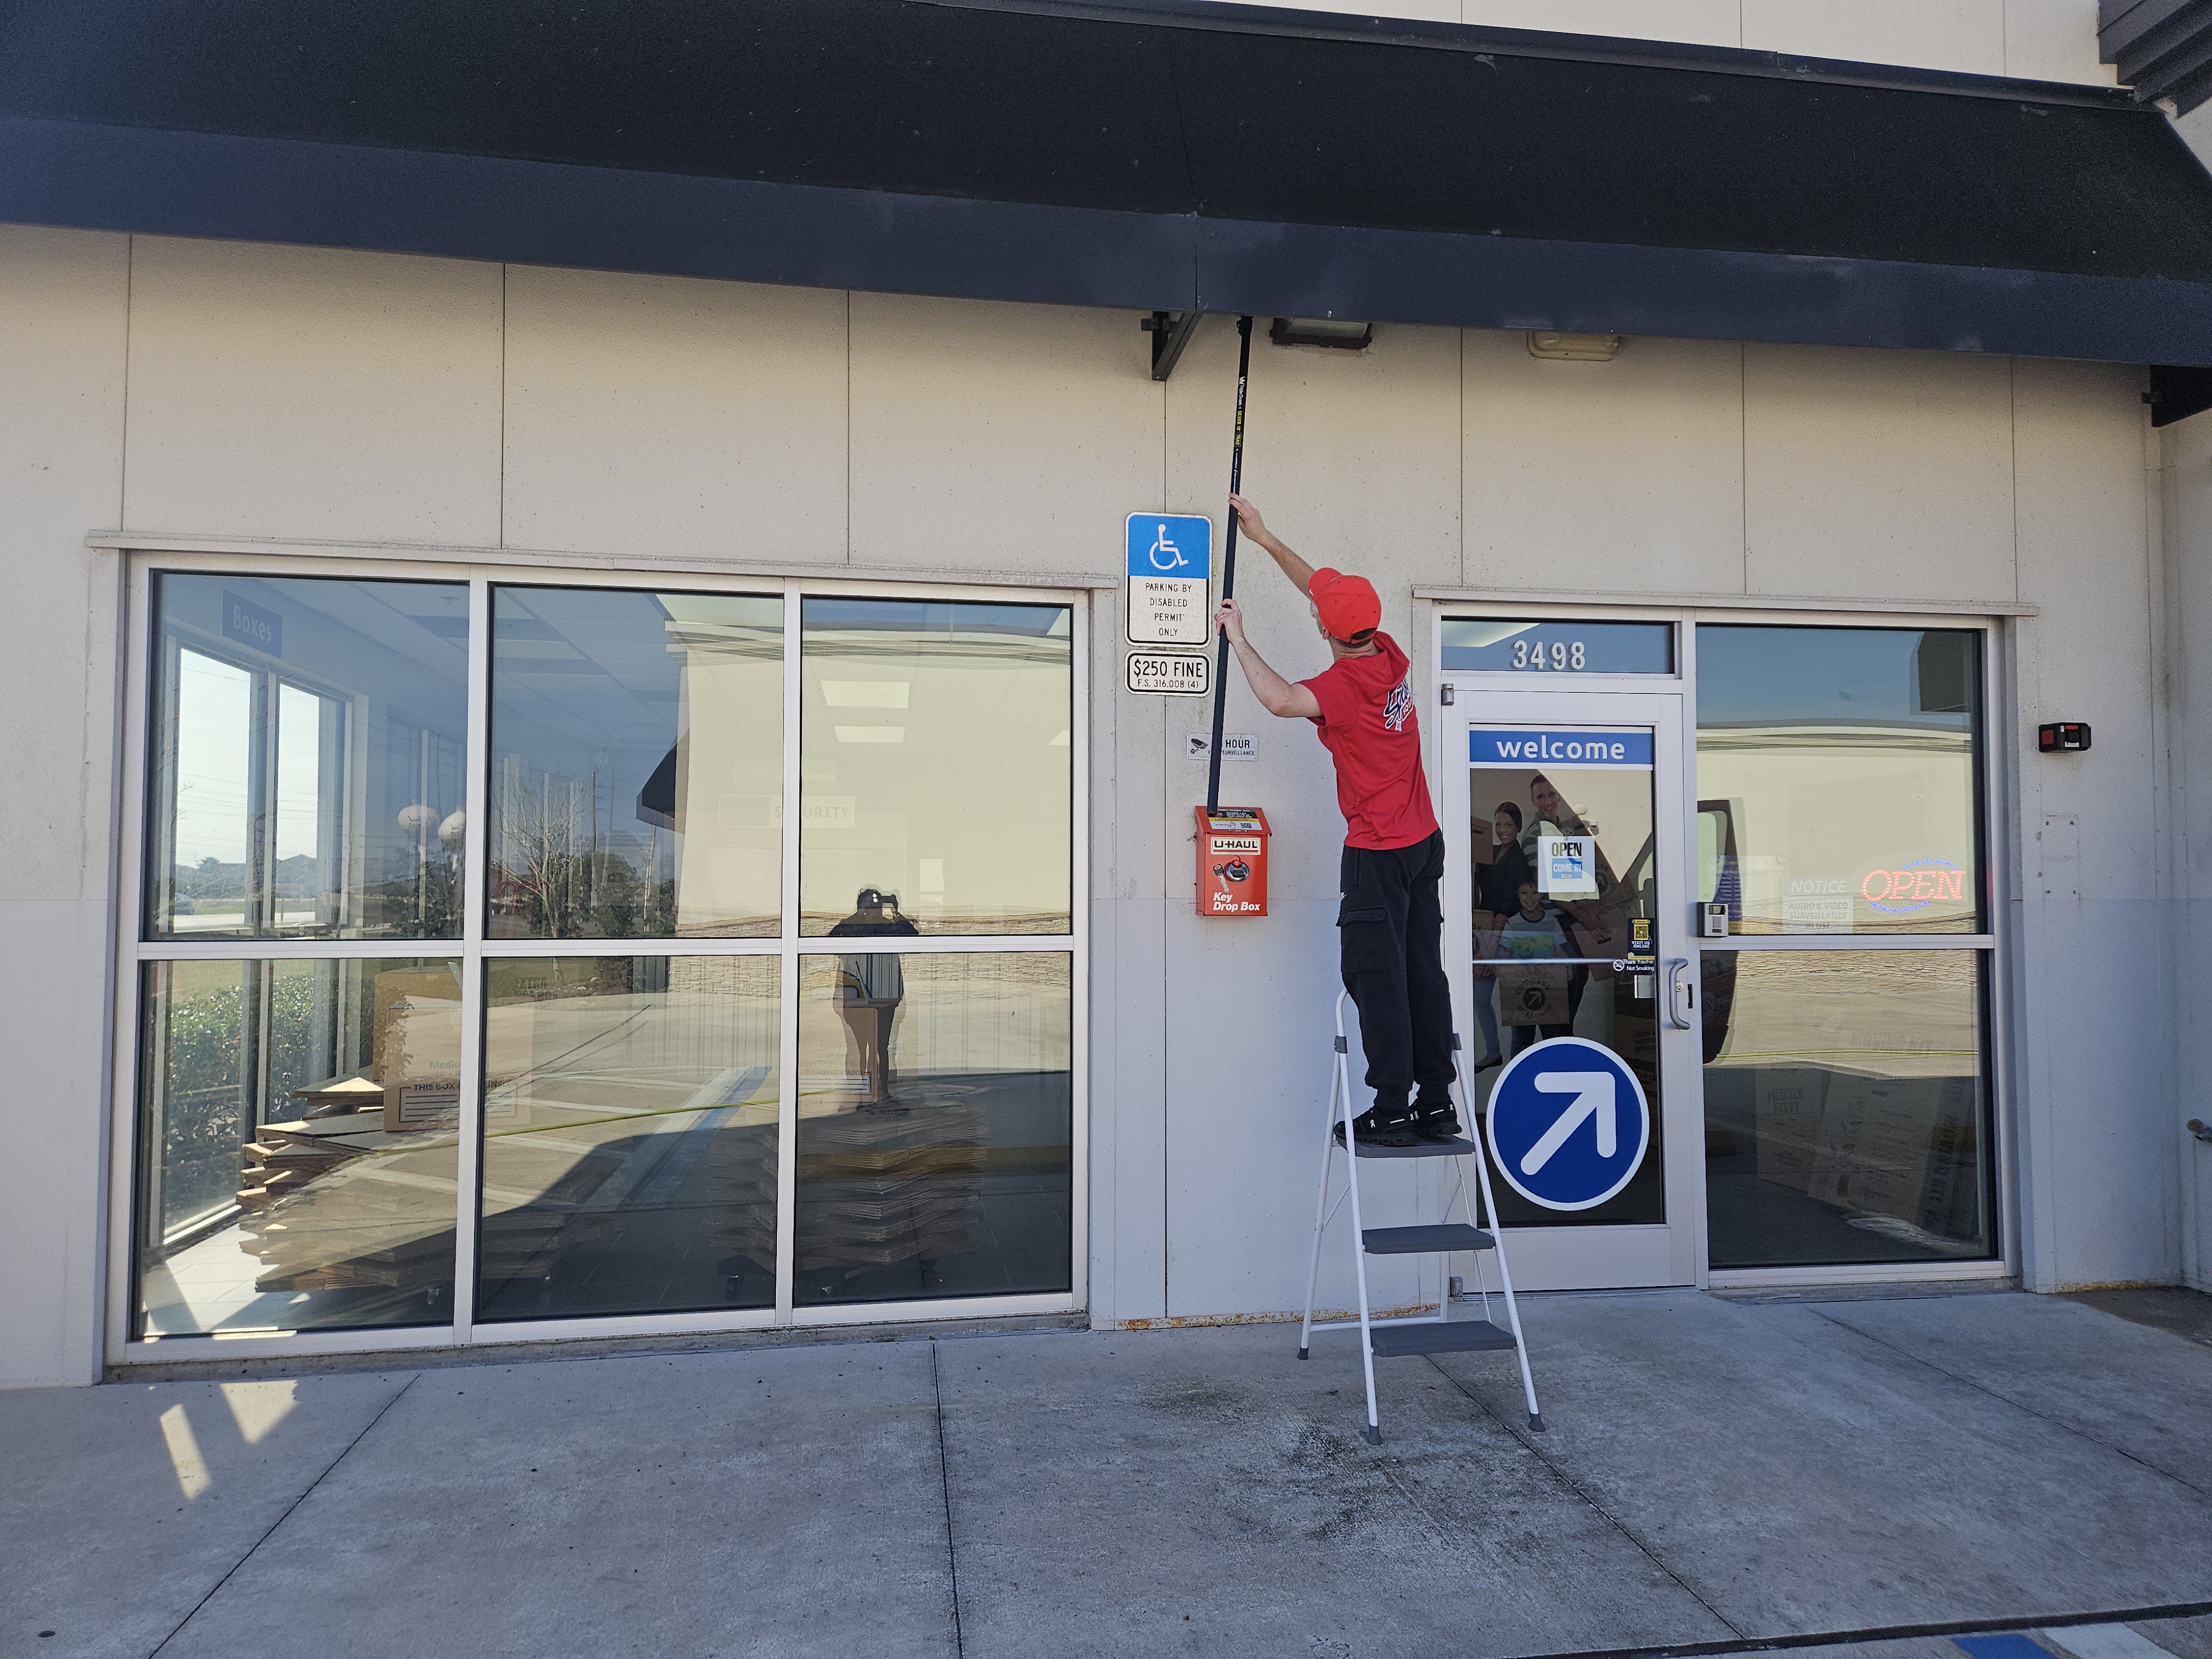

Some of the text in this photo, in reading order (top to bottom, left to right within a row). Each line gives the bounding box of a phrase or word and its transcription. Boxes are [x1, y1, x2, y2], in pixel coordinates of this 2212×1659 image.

[1146, 582, 1192, 592] PARKING BY
[1150, 598, 1187, 607] DISABLED
[1154, 613, 1182, 622] PERMIT
[233, 604, 272, 643] Boxes
[1159, 628, 1178, 636] ONLY
[1513, 640, 1585, 670] 3498
[1134, 658, 1203, 677] $250 FINE
[1138, 679, 1198, 688] F.S. 316.008 (4)
[1225, 739, 1250, 749] HOUR
[1496, 735, 1625, 759] welcome
[774, 806, 849, 818] SURITY
[1551, 842, 1582, 857] OPEN
[1553, 863, 1582, 872] COME IN
[1790, 880, 1847, 893] NOTICE
[1861, 869, 1965, 901] OPEN
[1213, 892, 1233, 903] Key
[1213, 901, 1261, 912] Drop Box
[430, 1060, 460, 1069] Mediu
